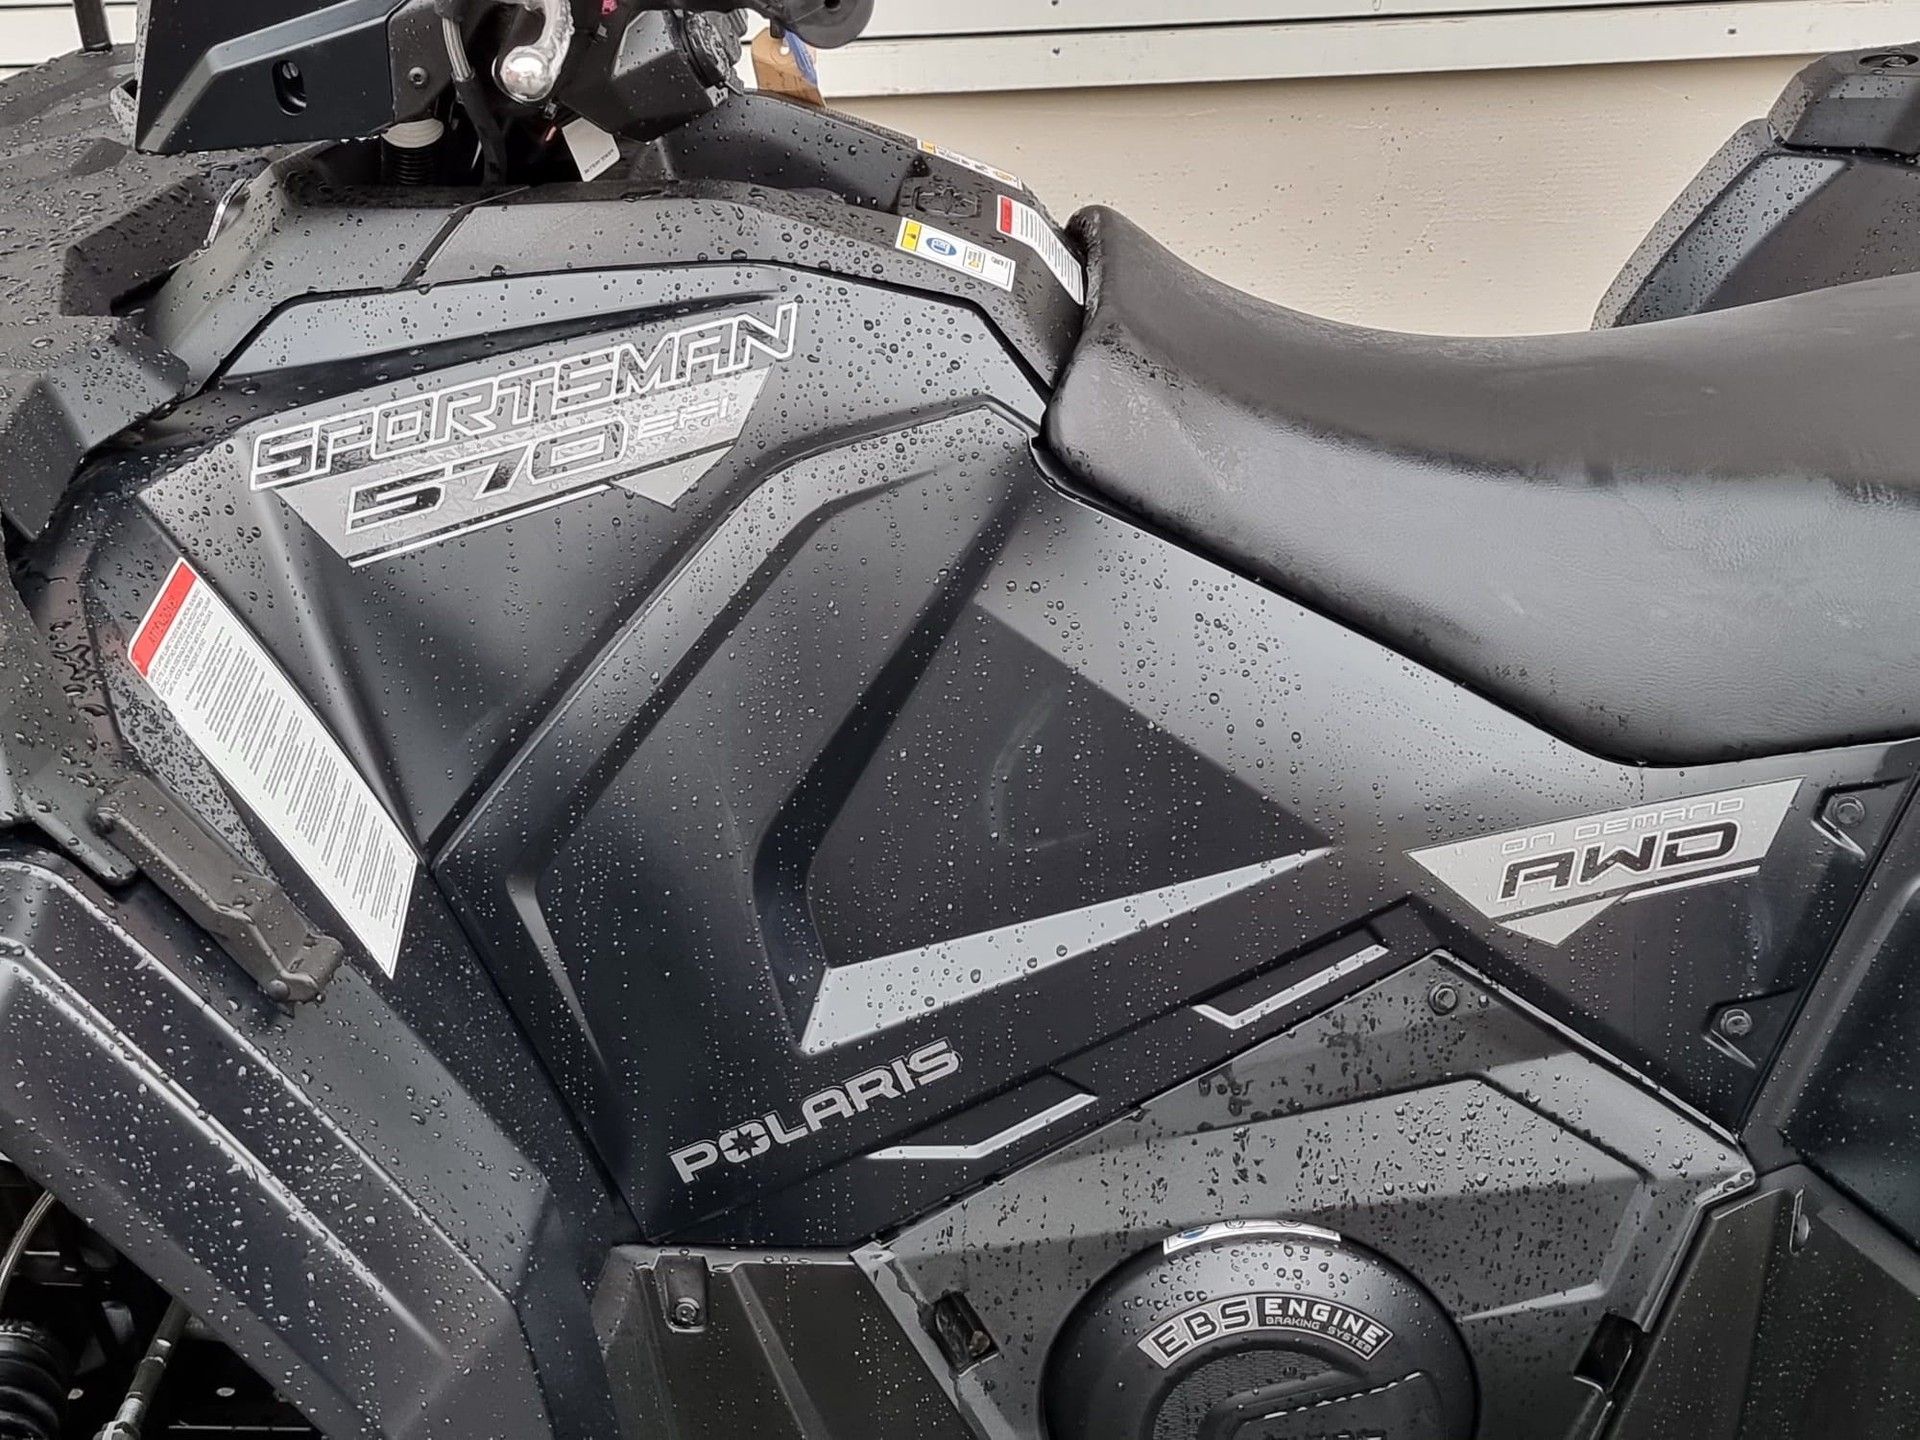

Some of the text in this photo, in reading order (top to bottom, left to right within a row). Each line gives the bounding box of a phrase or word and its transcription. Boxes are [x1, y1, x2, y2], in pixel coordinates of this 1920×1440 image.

[249, 301, 798, 491] SPORTSMAN
[345, 397, 729, 536] 570 EFI
[1497, 820, 1742, 904] AWD
[1501, 797, 1745, 855] ON DEMAND
[668, 1036, 962, 1183] POLARIS
[1149, 1298, 1385, 1361] EBS ENGINE
[1265, 1316, 1320, 1330] BRAKING
